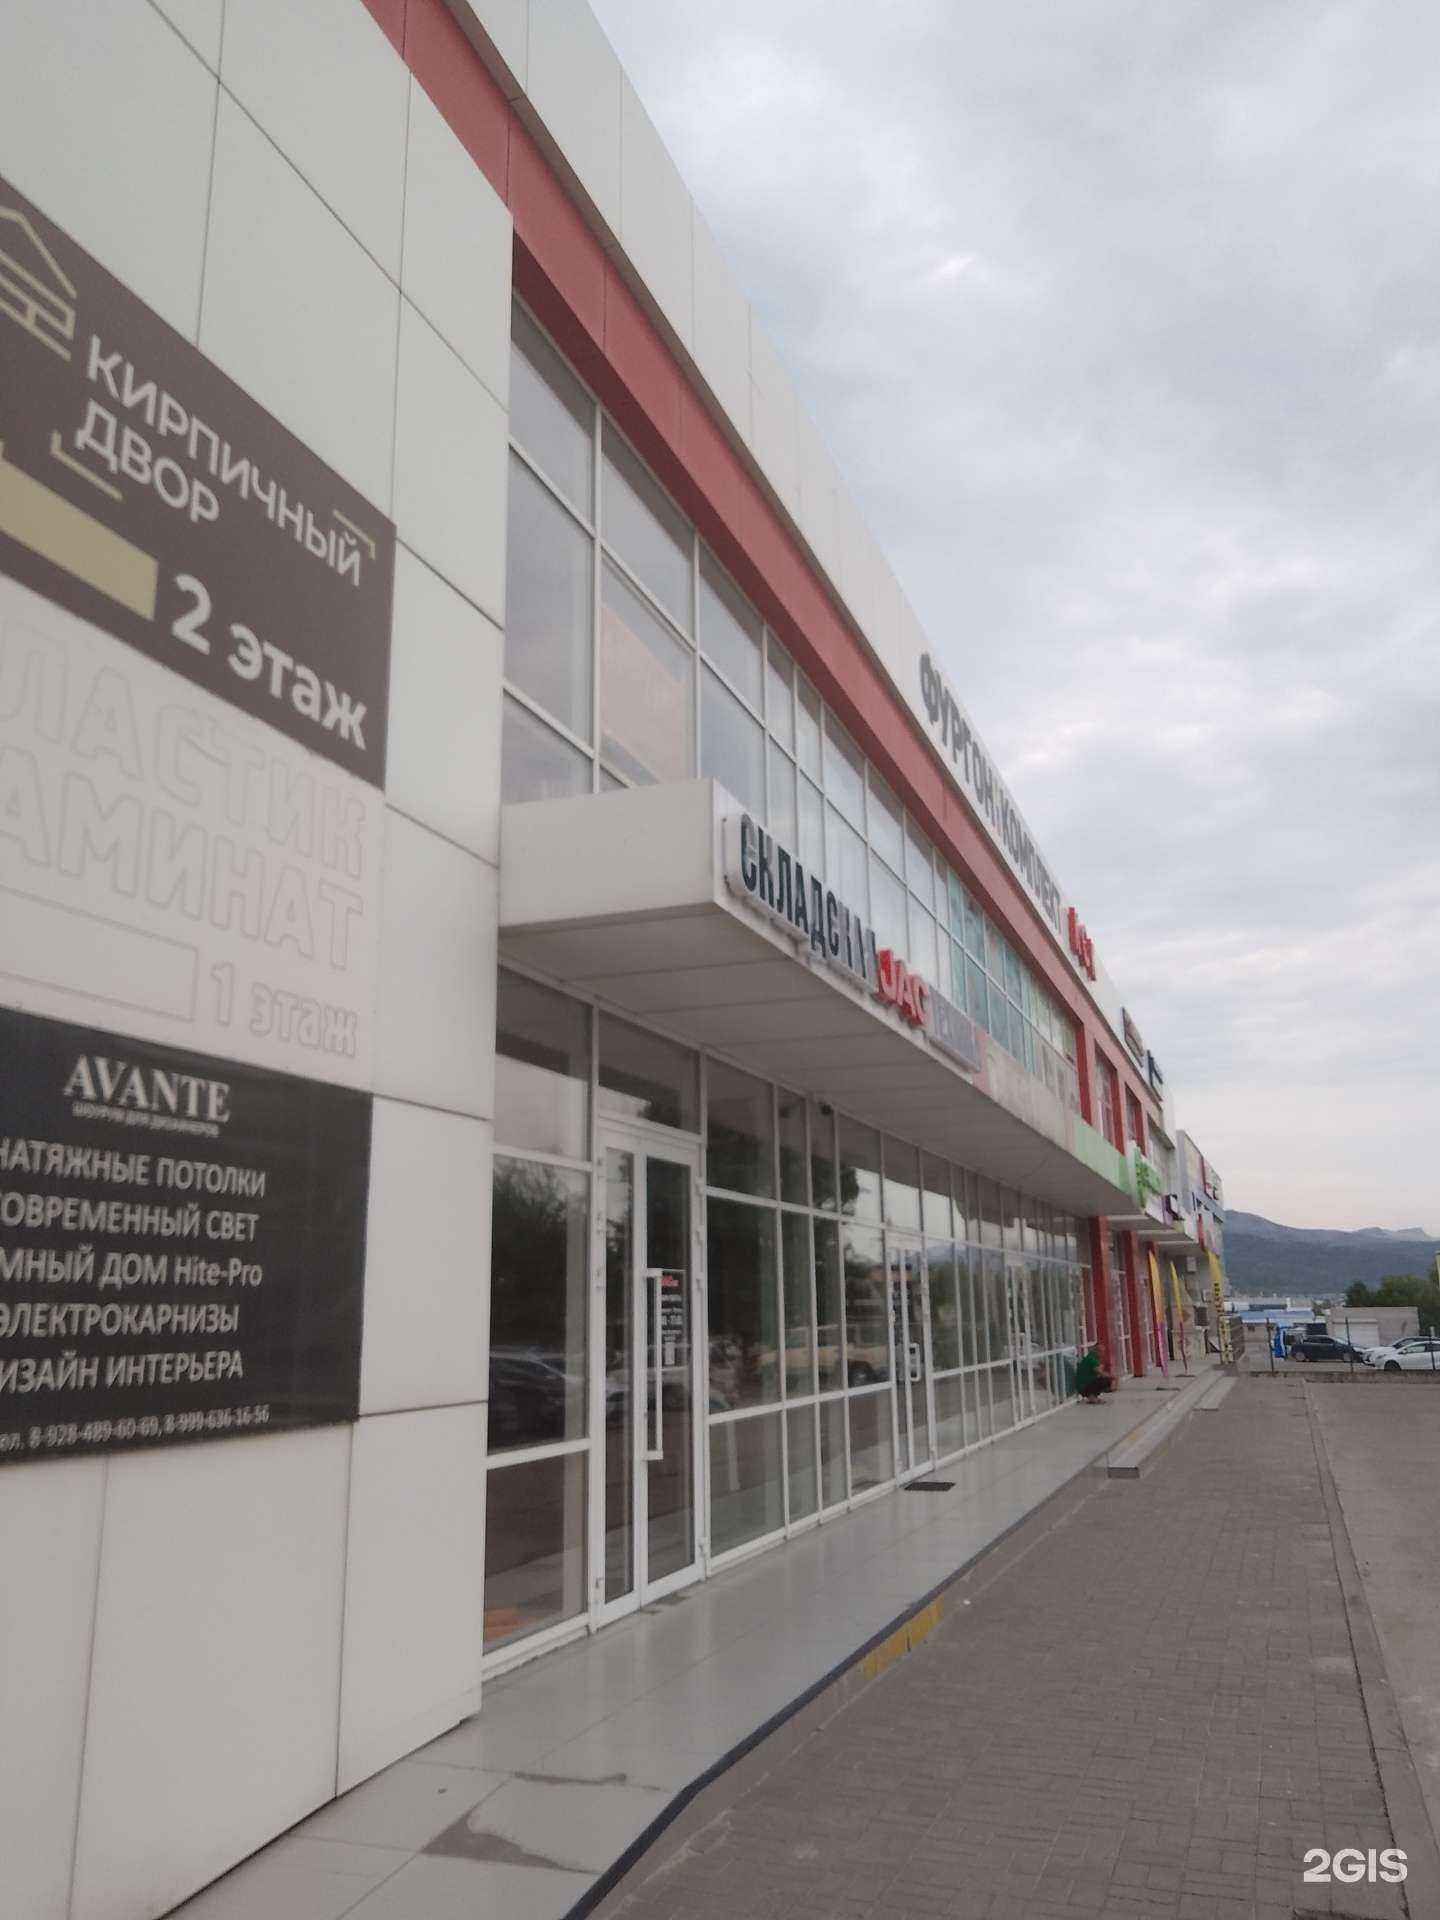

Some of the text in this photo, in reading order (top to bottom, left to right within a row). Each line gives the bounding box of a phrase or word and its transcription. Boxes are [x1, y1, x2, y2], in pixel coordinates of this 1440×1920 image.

[75, 398, 220, 523] ДВОР
[87, 335, 362, 586] КИРПИЧНЫЙ
[171, 573, 367, 750] 2 этаж
[211, 960, 360, 1061] 1 этаж
[64, 1054, 231, 1124] AVANTE
[157, 1162, 266, 1199] ПОТОЛКИ
[205, 1209, 260, 1243] СВЕТ
[98, 1252, 167, 1291] ДОМ
[106, 1350, 243, 1388] ИНТЕРЬЕРА
